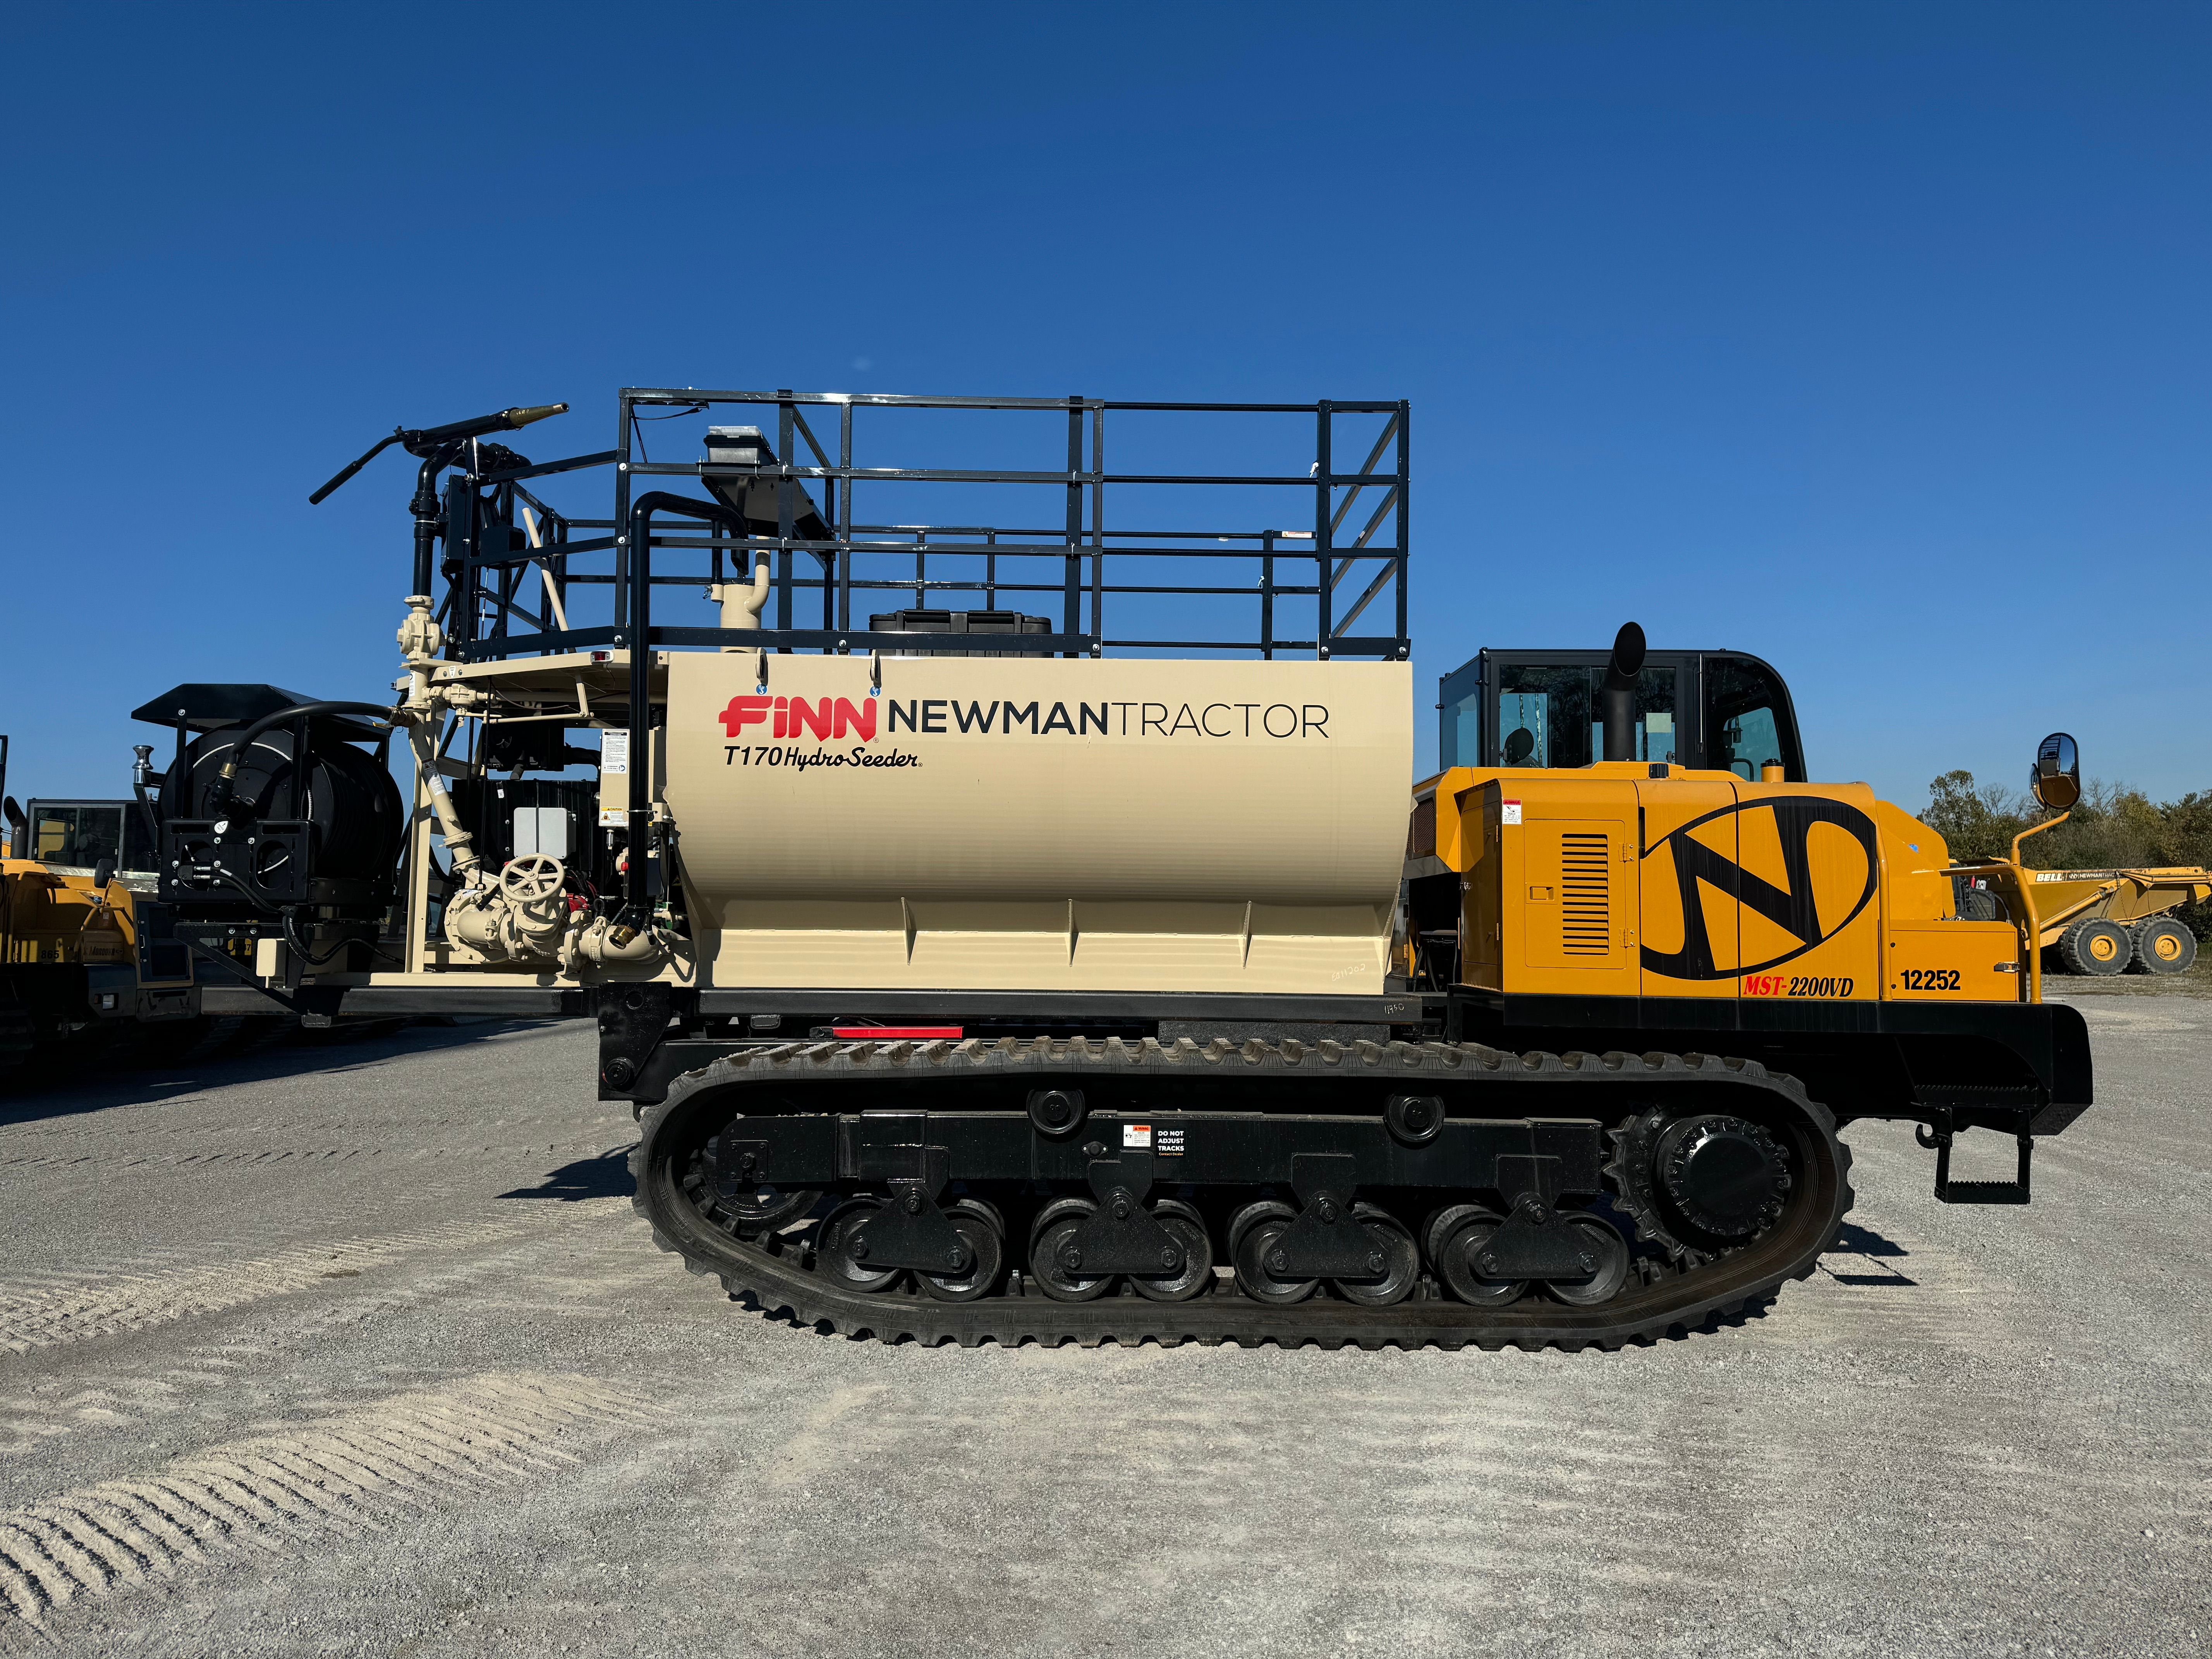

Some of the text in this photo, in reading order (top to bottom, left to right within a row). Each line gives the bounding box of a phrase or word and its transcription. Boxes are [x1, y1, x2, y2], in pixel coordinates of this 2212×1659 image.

[2036, 873, 2063, 882] BELL
[41, 950, 59, 959] 865
[1900, 969, 1961, 991] 12252
[1384, 1003, 1404, 1014] 11950
